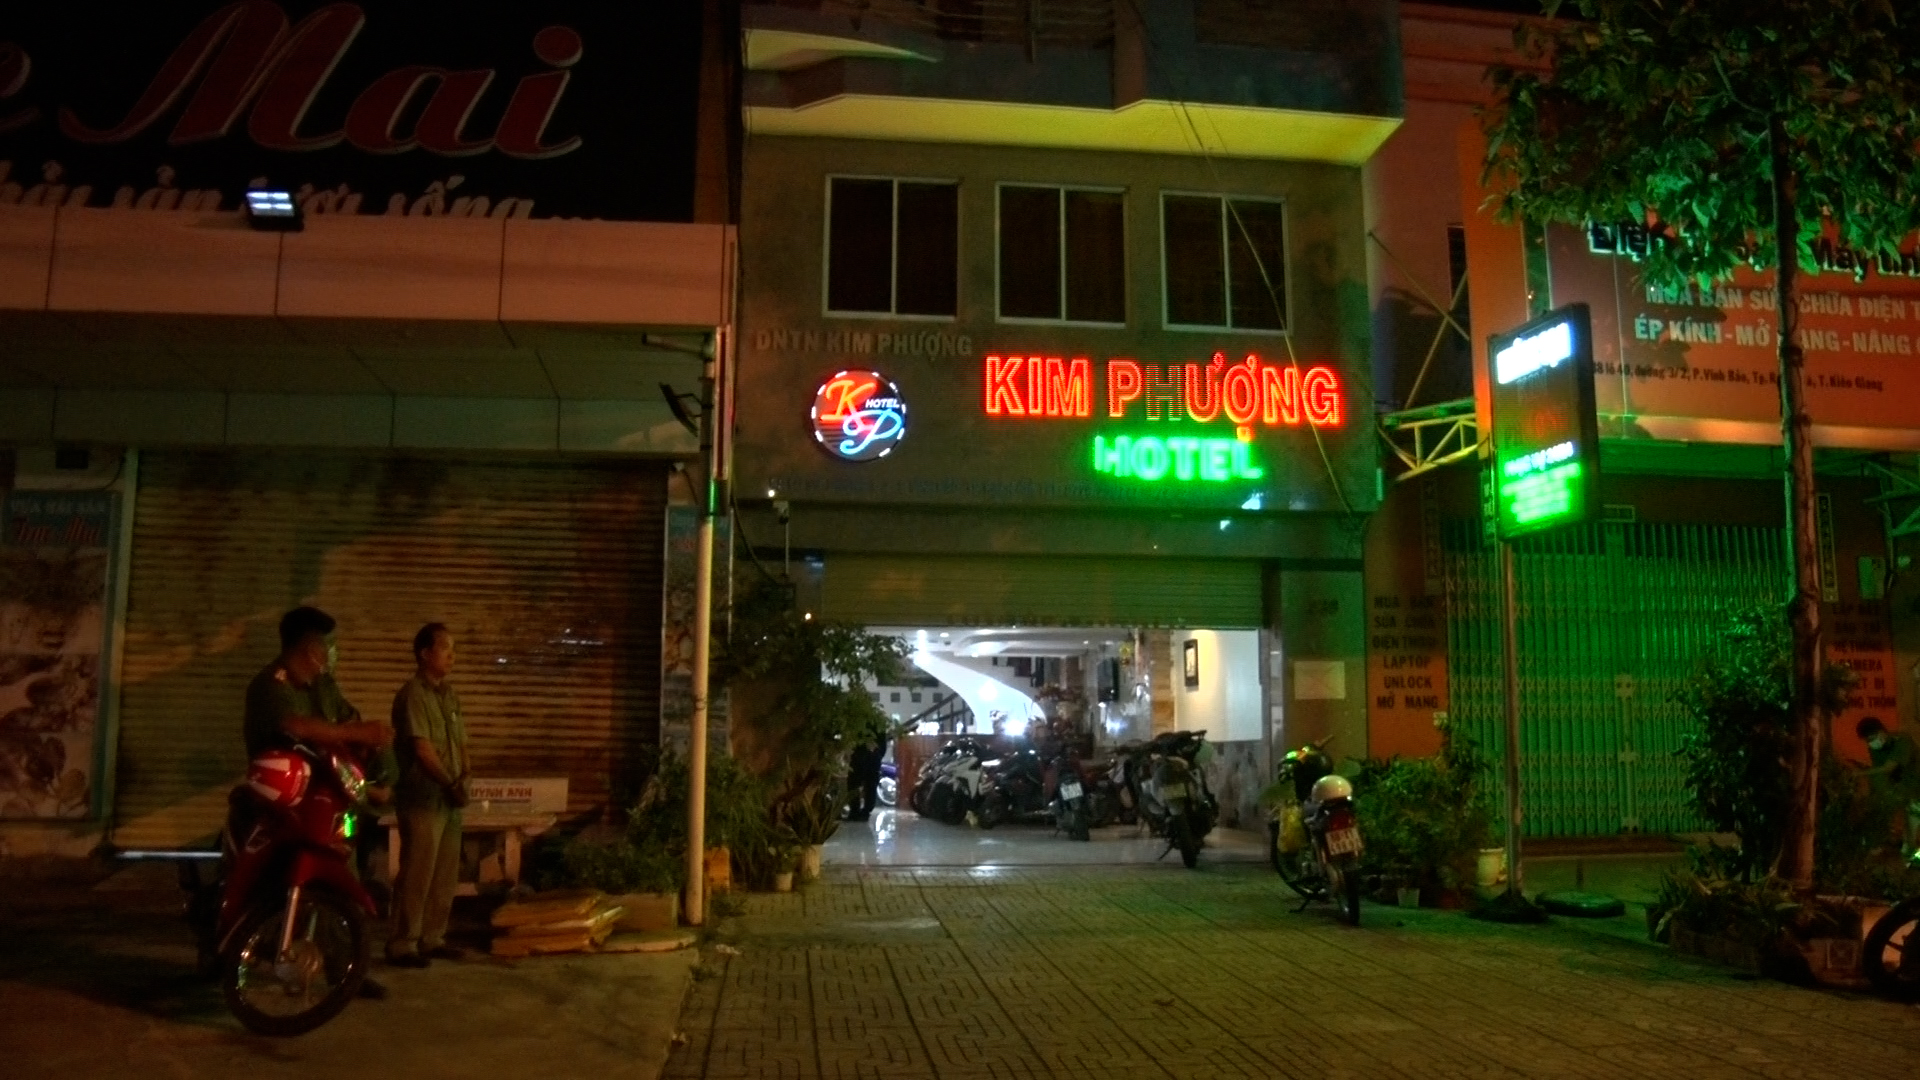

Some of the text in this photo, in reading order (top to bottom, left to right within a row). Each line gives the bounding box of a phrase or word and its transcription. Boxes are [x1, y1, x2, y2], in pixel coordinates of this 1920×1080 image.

[60, 0, 583, 158] Mai
[1634, 312, 1662, 341] ÉP
[755, 328, 973, 362] DNTN KIM PHƯỢNG
[865, 398, 900, 408] HOTEL
[985, 351, 1342, 442] KIM PHƯỢNG
[1093, 434, 1264, 481] HOTEL
[1383, 655, 1431, 669] LAPTOP
[1383, 675, 1433, 689] UNLOCK
[507, 786, 533, 798] ANH
